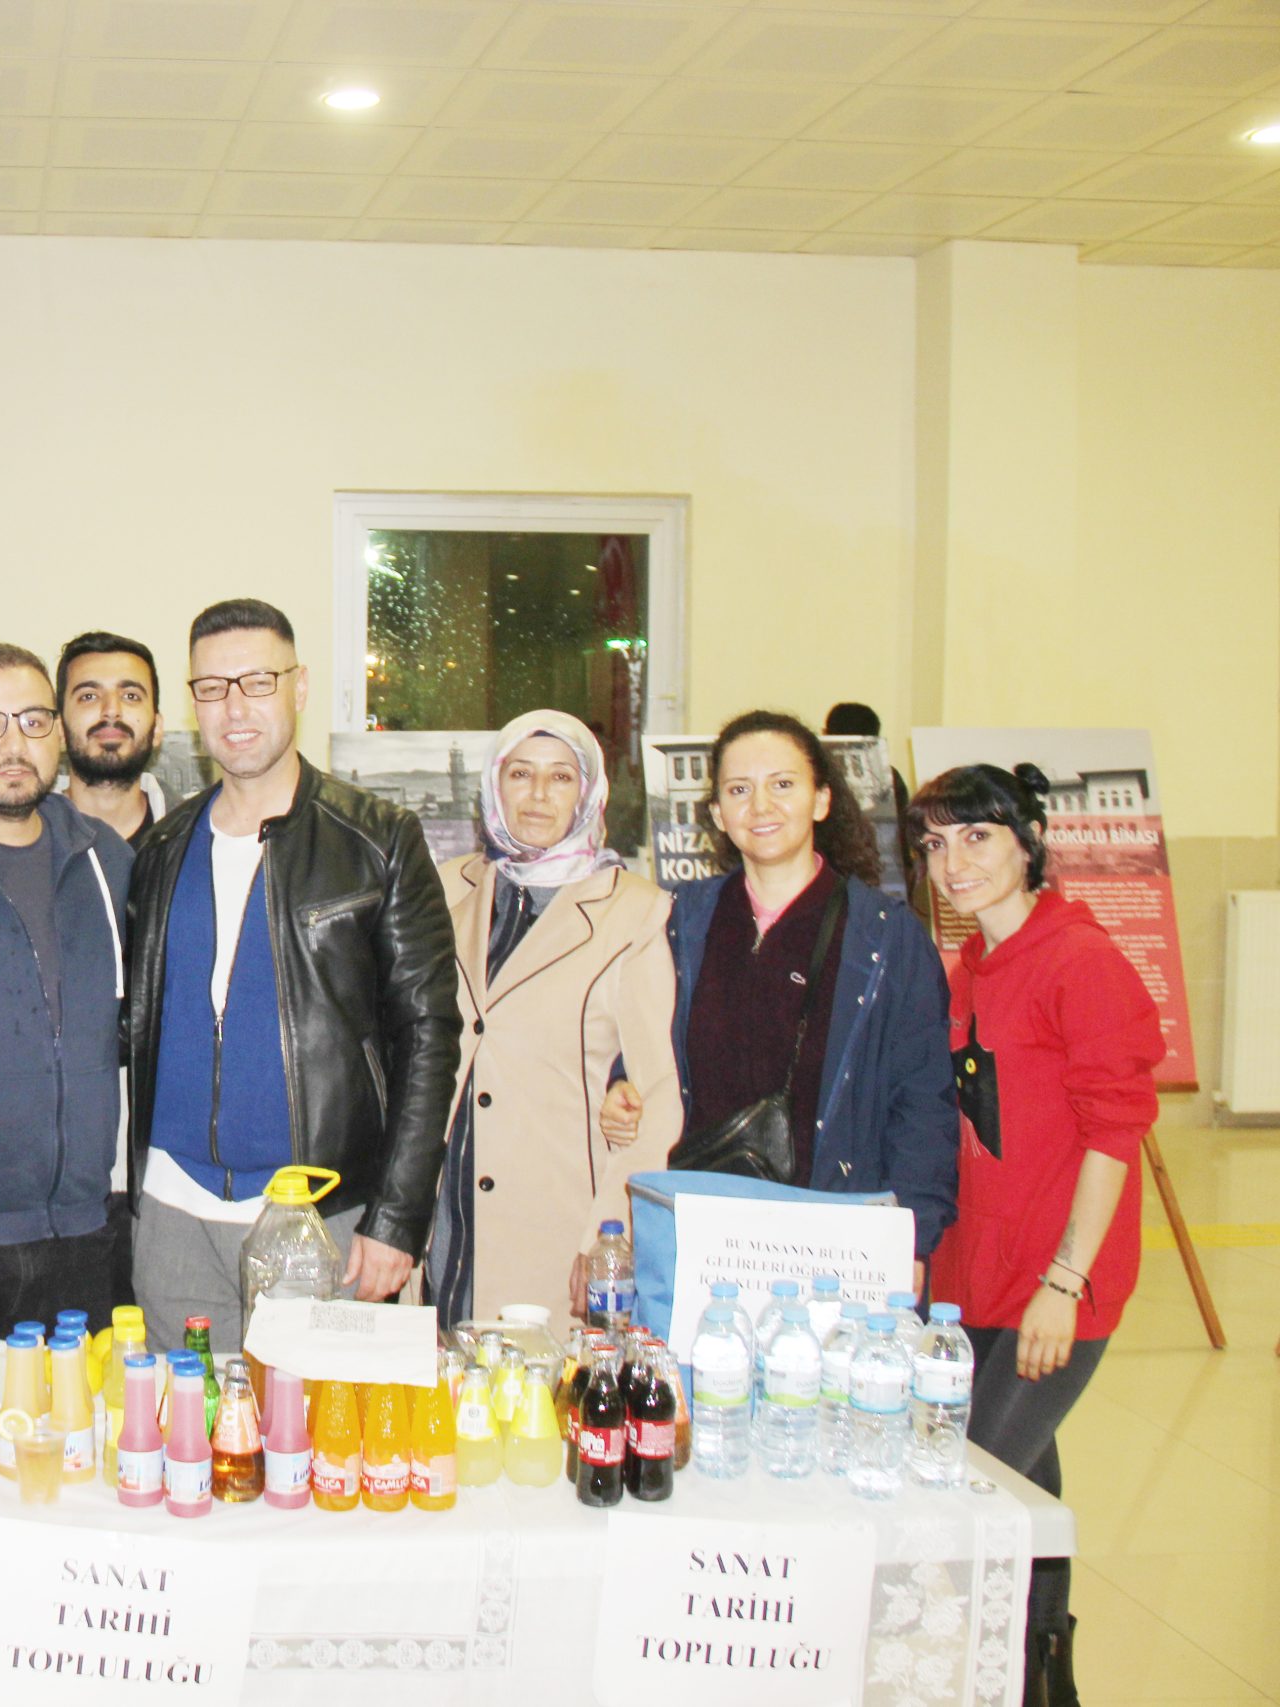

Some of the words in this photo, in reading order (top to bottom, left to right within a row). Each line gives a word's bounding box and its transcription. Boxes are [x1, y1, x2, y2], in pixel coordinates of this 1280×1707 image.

[658, 829, 715, 854] NİZA
[661, 857, 720, 881] KON
[724, 1237, 745, 1250] BU
[61, 1558, 174, 1592] SANAT
[689, 1548, 797, 1580] SANAT
[53, 1601, 172, 1637] TARİHİ
[681, 1592, 795, 1624] TARİHİ
[7, 1643, 214, 1685] TOPLULUĞU
[636, 1634, 832, 1670] TOPLULUĞU
